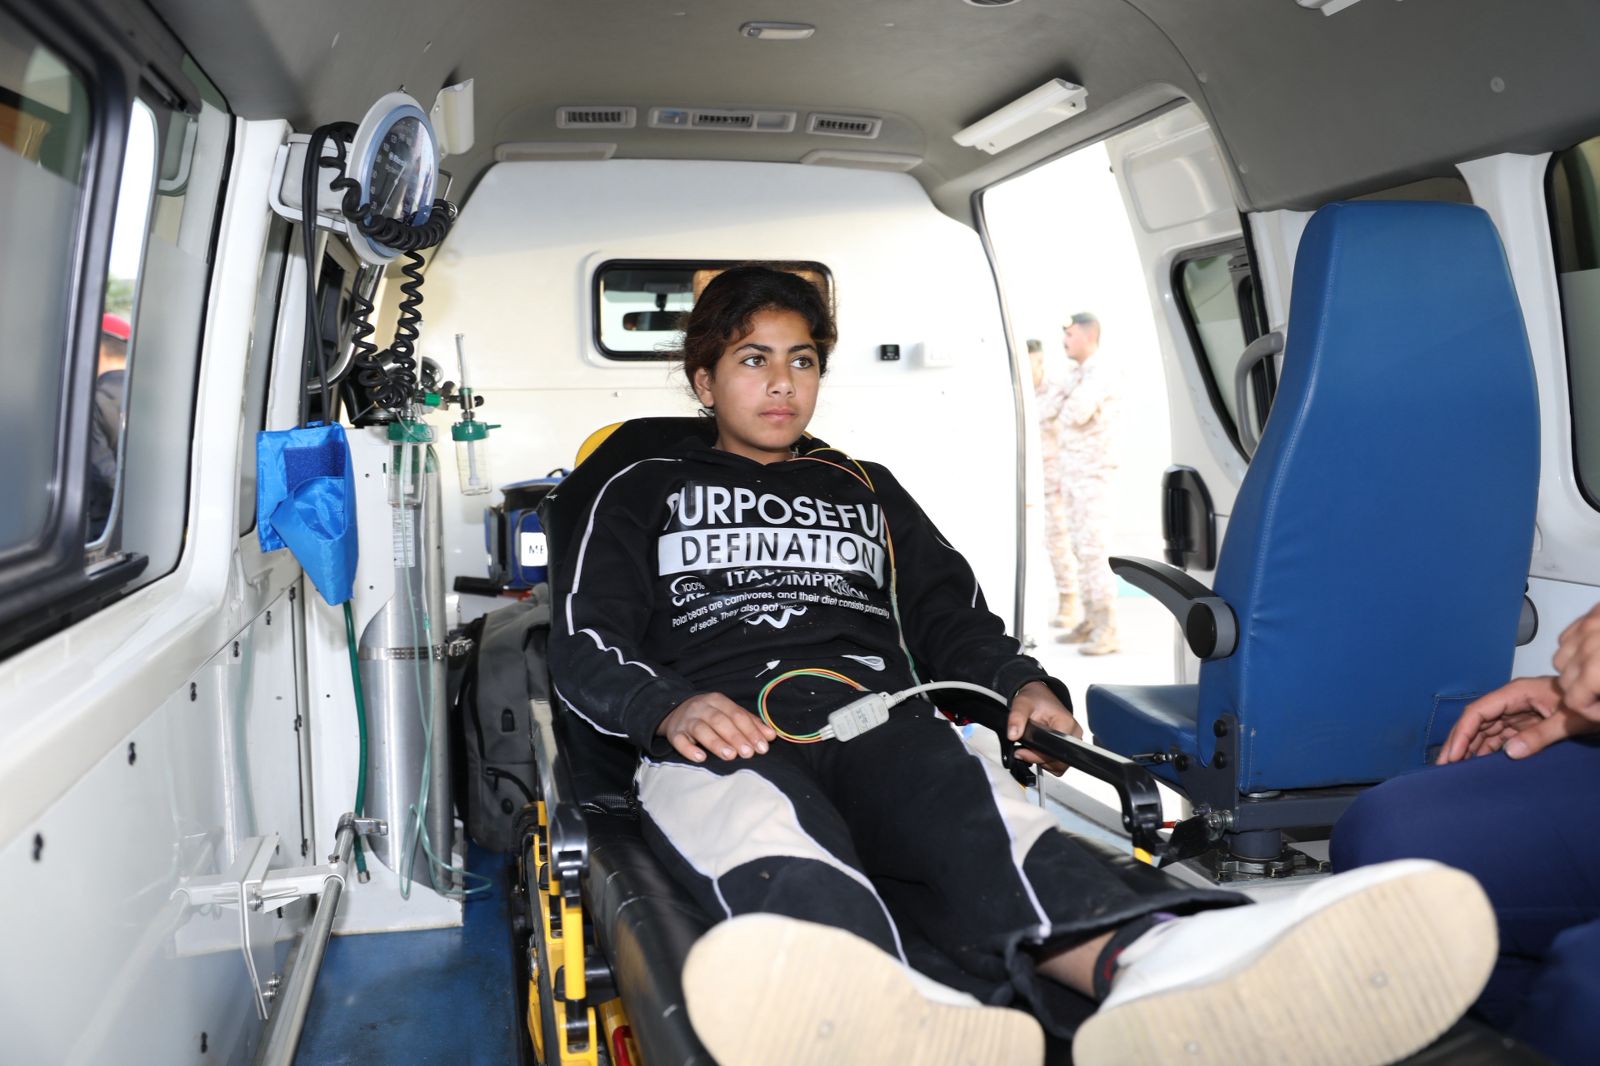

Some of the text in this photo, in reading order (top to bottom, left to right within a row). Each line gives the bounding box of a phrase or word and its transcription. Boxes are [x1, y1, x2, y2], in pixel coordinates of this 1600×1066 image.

[681, 532, 875, 576] DEFINATION
[681, 582, 705, 593] 100%
[671, 615, 688, 628] Polar
[688, 605, 708, 620] bears
[708, 601, 723, 611] are
[725, 591, 775, 606] carnivores,
[777, 591, 797, 600] and
[798, 591, 820, 603] their
[821, 595, 838, 606] diet
[838, 599, 865, 612] consists
[689, 622, 698, 633] of
[720, 608, 739, 621] They
[740, 603, 760, 613] also
[761, 602, 779, 612] eat
